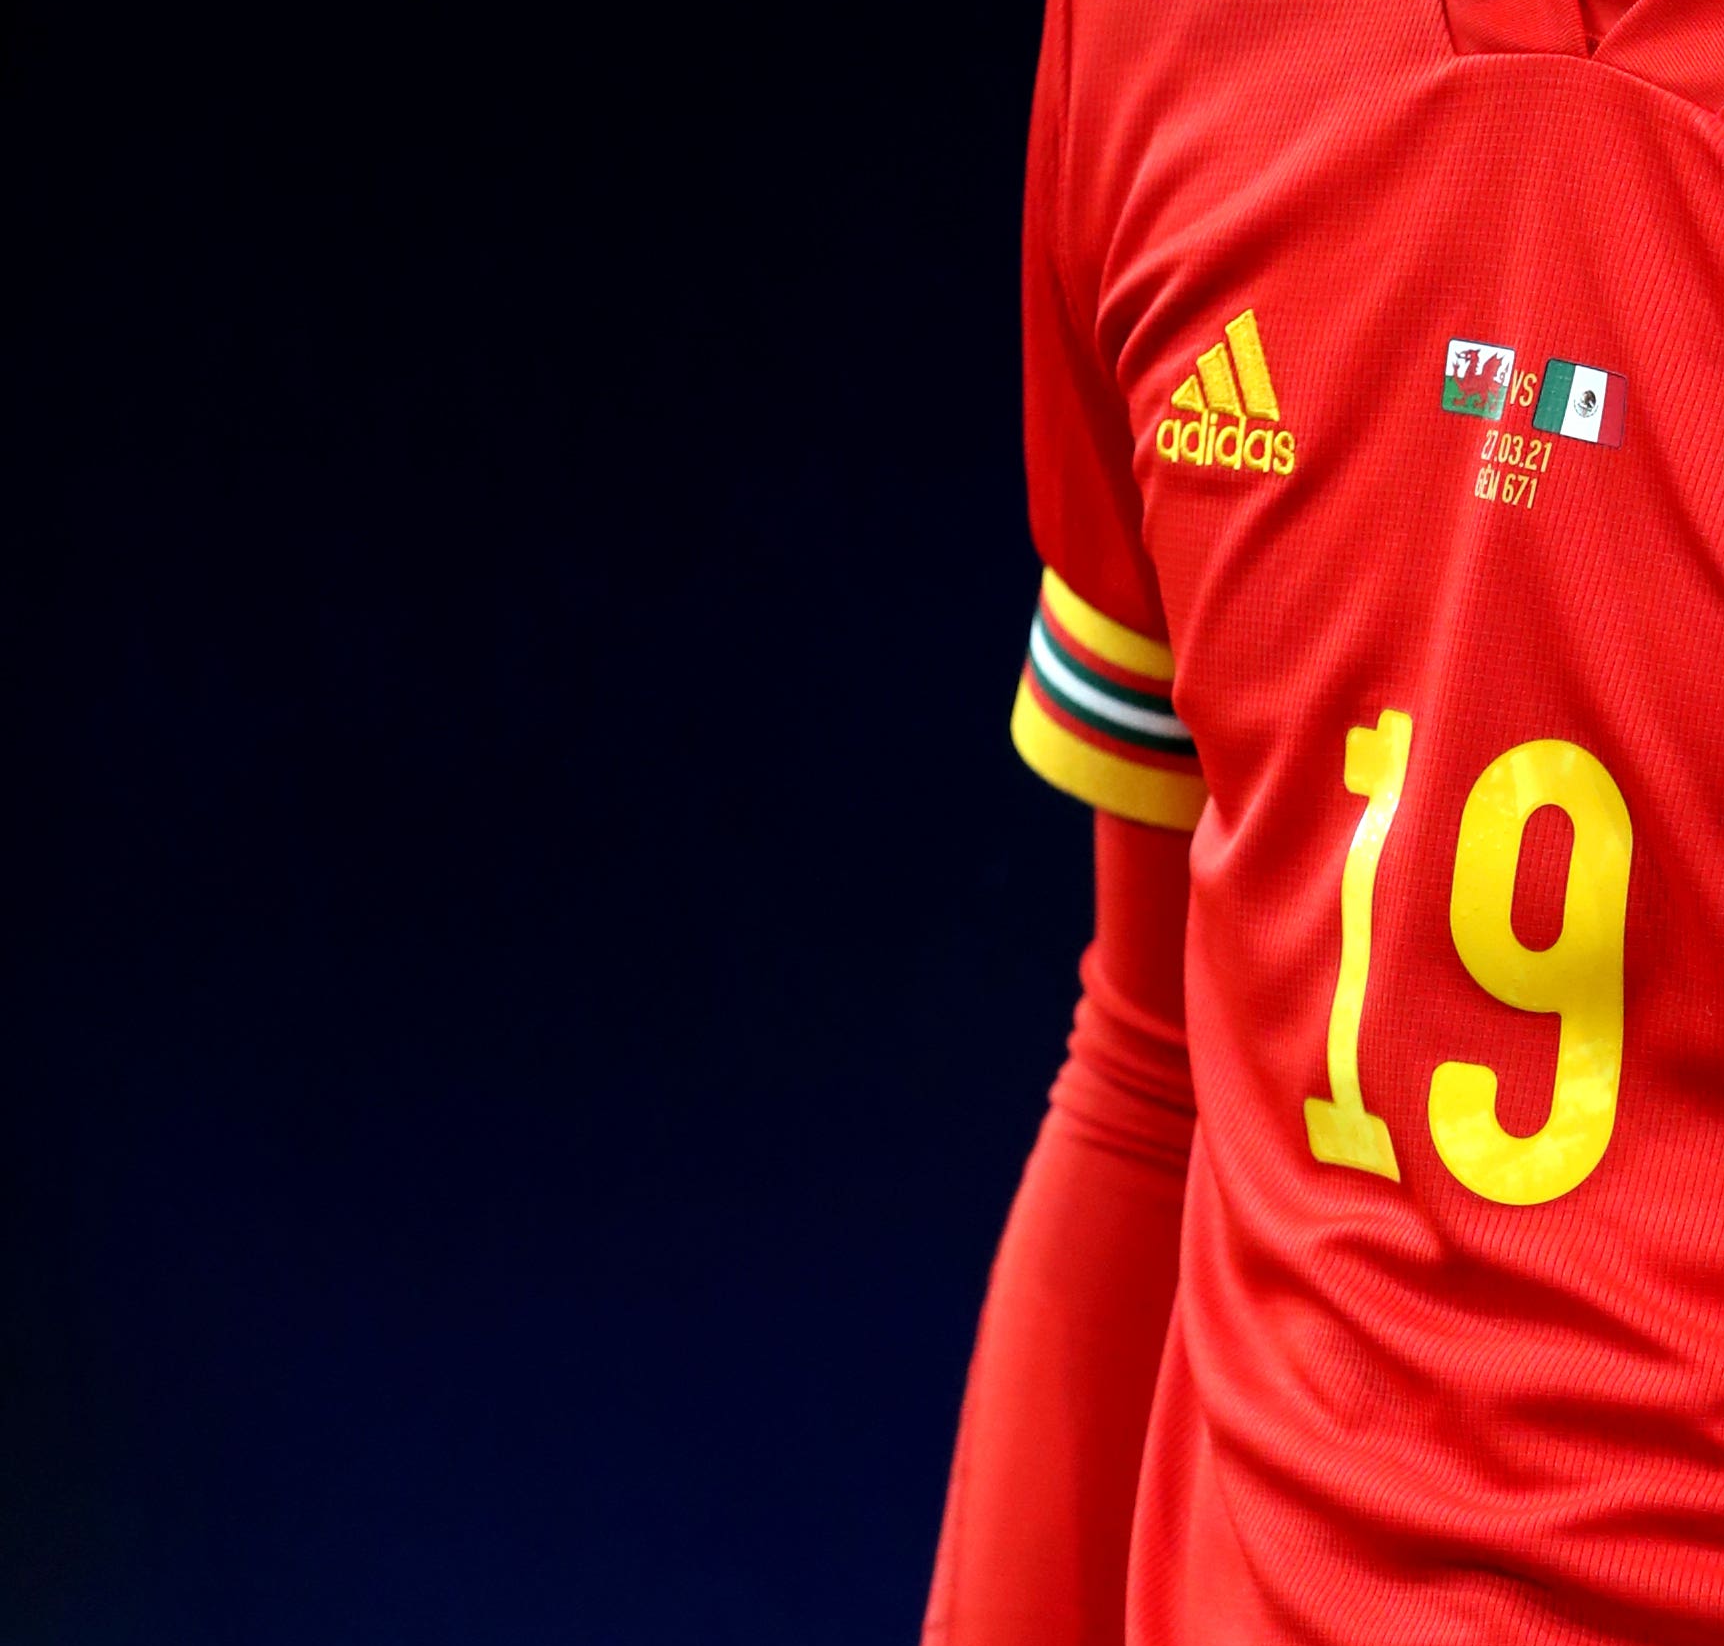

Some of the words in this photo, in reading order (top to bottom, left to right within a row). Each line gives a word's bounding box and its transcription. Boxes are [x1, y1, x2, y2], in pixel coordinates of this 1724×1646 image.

[1509, 369, 1538, 408] VS
[1156, 409, 1295, 475] adidas
[1481, 428, 1554, 473] 27.03.21
[1502, 472, 1539, 510] 671
[1303, 708, 1633, 1206] 19
